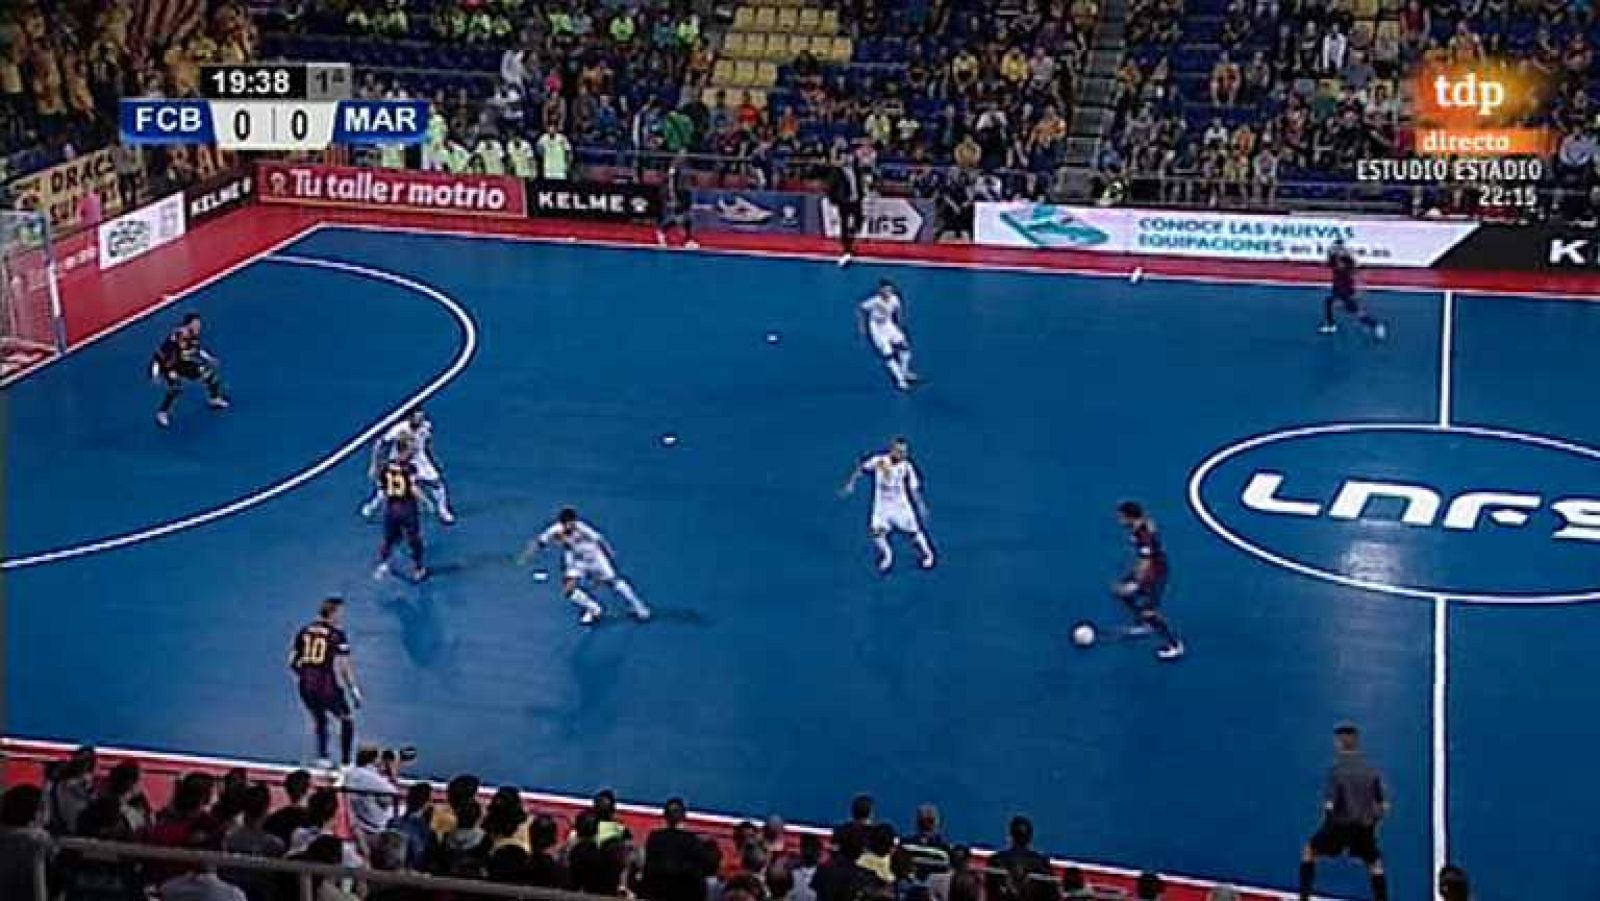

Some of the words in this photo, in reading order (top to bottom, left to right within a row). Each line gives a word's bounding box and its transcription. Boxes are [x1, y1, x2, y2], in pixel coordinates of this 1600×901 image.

[290, 168, 322, 197] Tu
[326, 172, 405, 204] taller
[407, 180, 506, 210] motrio
[537, 191, 625, 213] KELME
[1138, 216, 1222, 234] CONOCE
[1230, 219, 1266, 236] LAS
[1271, 223, 1355, 240] NUEVAS
[1138, 232, 1285, 255] EQUIPACIONES
[1550, 239, 1600, 264] K
[301, 633, 326, 664] 10
